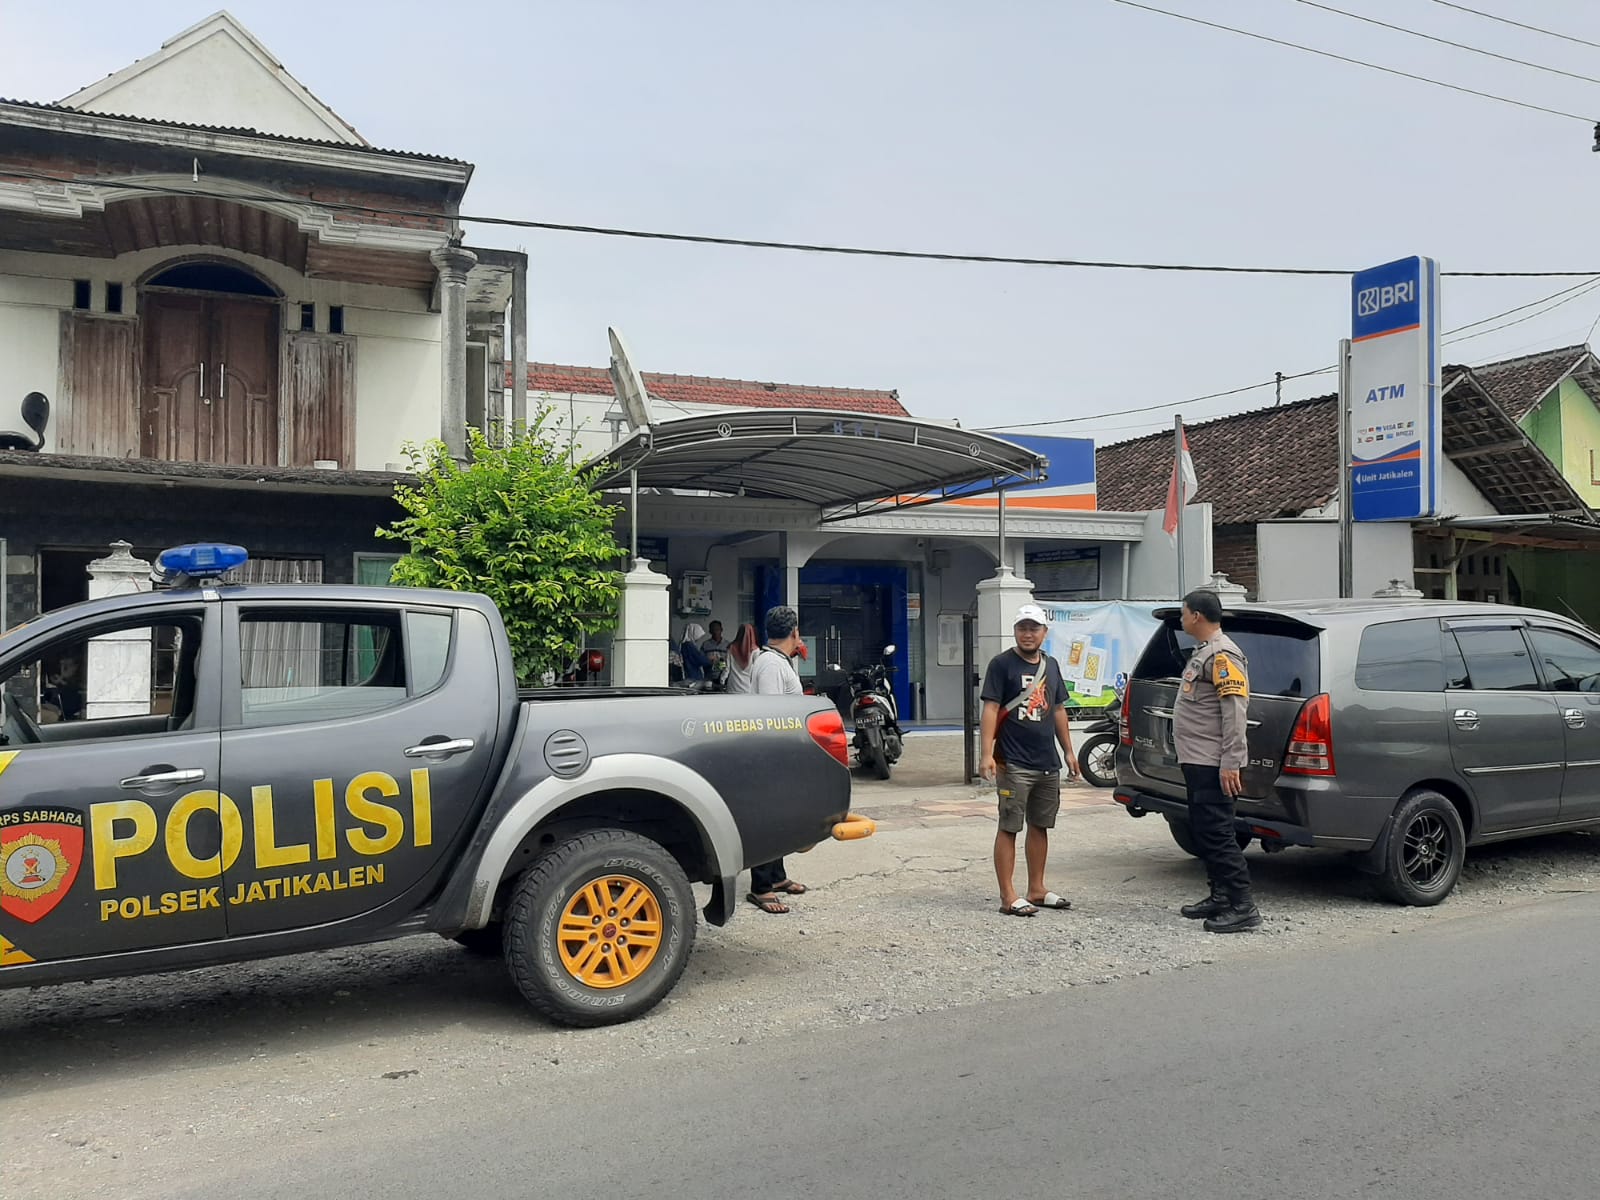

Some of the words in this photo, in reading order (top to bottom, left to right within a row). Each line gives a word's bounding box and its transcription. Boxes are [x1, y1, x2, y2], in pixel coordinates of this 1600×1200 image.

[1381, 280, 1414, 308] BRI
[1365, 383, 1405, 404] ATM
[1361, 474, 1377, 482] Unit
[1378, 470, 1414, 481] Jatikalen
[703, 720, 723, 733] 110
[726, 718, 764, 733] BEBAS
[766, 717, 803, 730] PULSA
[23, 810, 82, 825] SABHARA
[90, 767, 432, 891] POLISI
[100, 886, 220, 922] POLSEK
[229, 863, 385, 906] JATIKALEN
